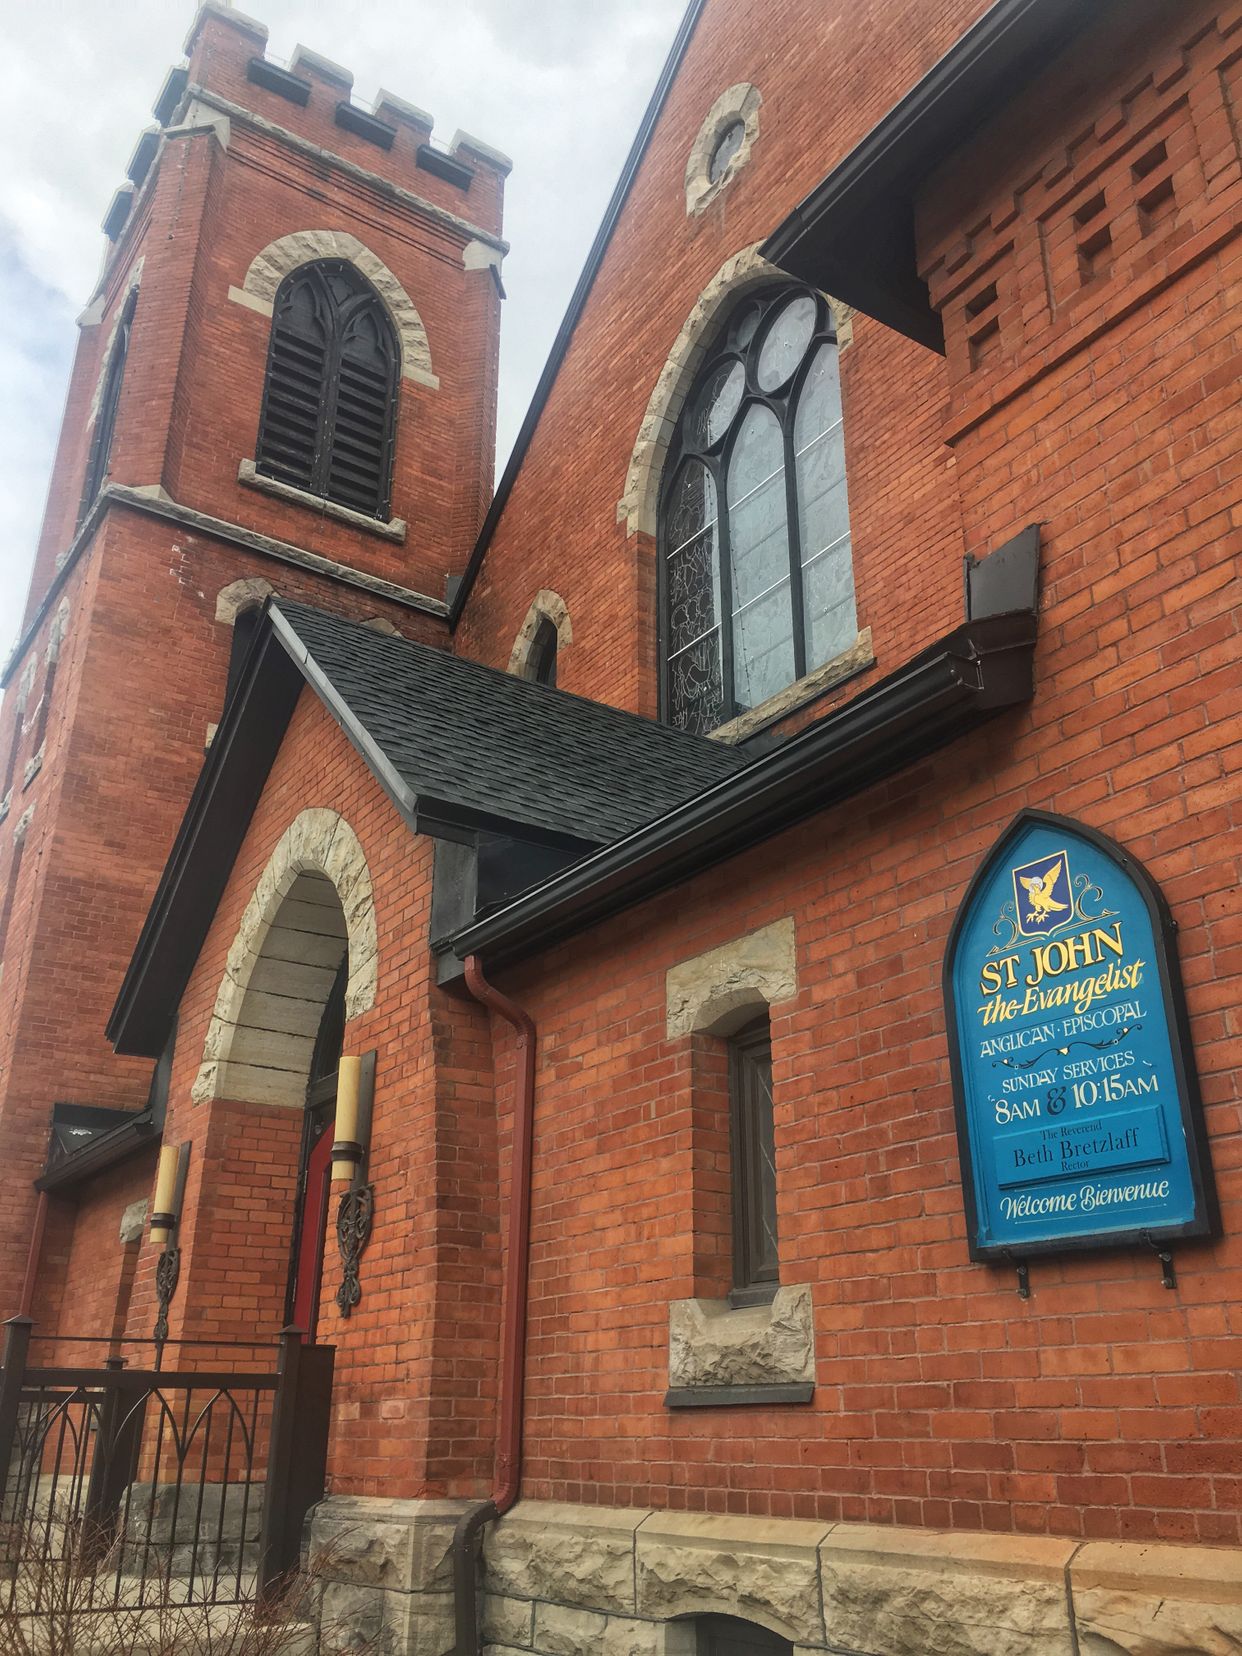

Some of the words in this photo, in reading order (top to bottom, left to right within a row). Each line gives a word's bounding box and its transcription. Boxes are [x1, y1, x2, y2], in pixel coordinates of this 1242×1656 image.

[980, 954, 1020, 997] ST
[1025, 921, 1124, 987] JOHN
[977, 994, 1022, 1026] the
[1021, 958, 1146, 1015] Evangelist
[980, 1024, 1055, 1058] ANGLICAN
[1063, 1000, 1147, 1037] EPISCOPAL
[1002, 1067, 1059, 1094] SUNDAY
[1063, 1050, 1136, 1081] SERVICES
[994, 1098, 1041, 1125] 8AM
[1046, 1086, 1067, 1116] &
[1070, 1073, 1159, 1109] 10:15AM
[1013, 1144, 1054, 1168] Beth
[1060, 1127, 1140, 1160] Bretzlaff
[1040, 1127, 1058, 1141] The
[1060, 1119, 1103, 1138] Reverend
[1061, 1159, 1090, 1172] Rector
[1000, 1192, 1077, 1220] Welcome
[1079, 1180, 1170, 1212] Bienvenue
